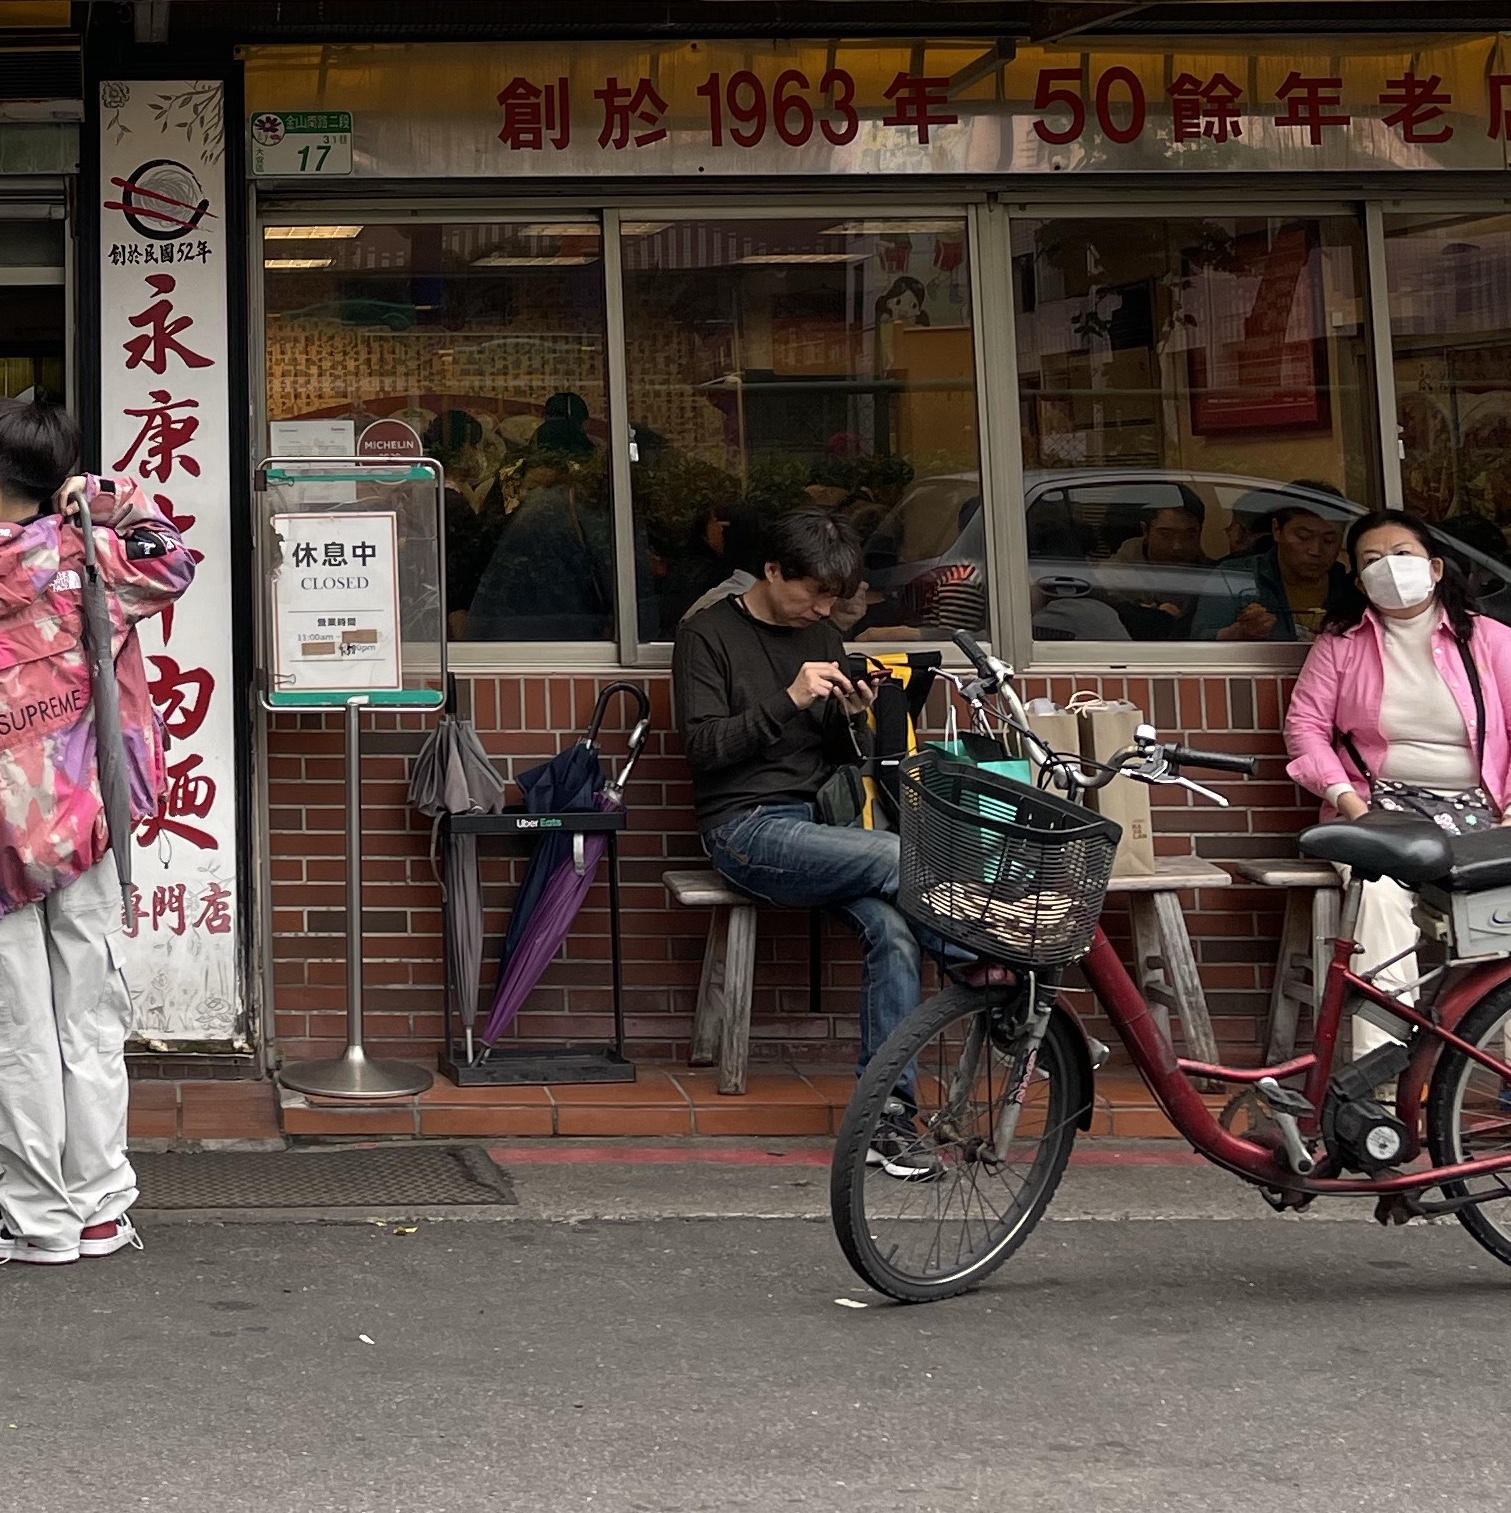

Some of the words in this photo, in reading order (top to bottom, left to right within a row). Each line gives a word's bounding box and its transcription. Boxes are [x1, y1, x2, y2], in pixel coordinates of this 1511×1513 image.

[286, 114, 349, 128] 金山南路二段
[298, 146, 331, 171] 17
[365, 440, 414, 450] MICHELIN
[292, 541, 377, 568] 休息中
[300, 576, 369, 591] CLOSED
[516, 818, 539, 828] Uber
